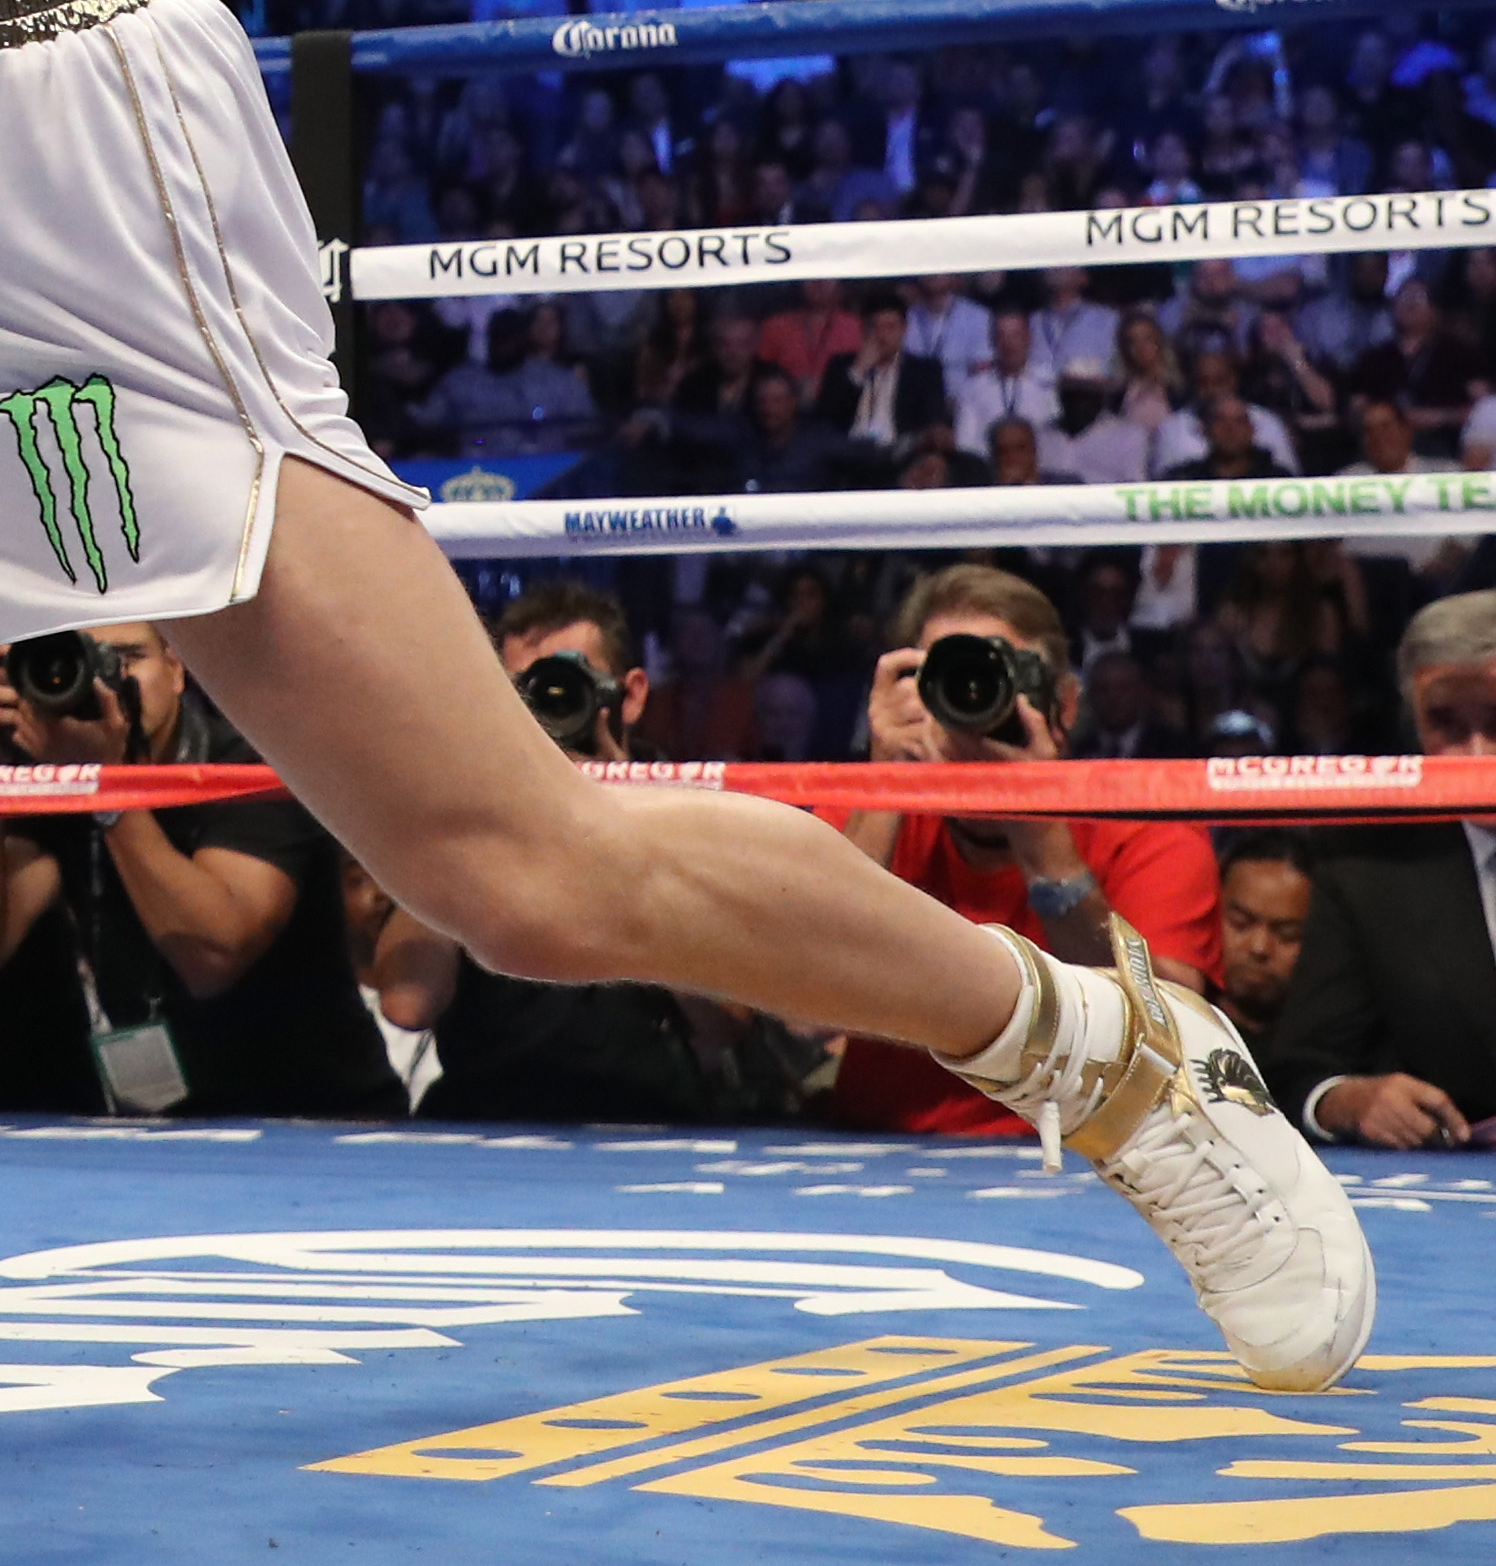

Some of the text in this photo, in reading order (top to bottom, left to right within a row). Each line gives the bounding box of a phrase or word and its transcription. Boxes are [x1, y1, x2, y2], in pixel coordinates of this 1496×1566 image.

[552, 18, 679, 58] Corona
[1086, 193, 1493, 247] MGM RESORTS
[428, 231, 793, 280] MGM RESORTS
[564, 506, 706, 534] MAYWEATHER
[1115, 486, 1213, 522] THE
[1225, 477, 1412, 519] MONEY
[575, 761, 727, 782] GREGOR
